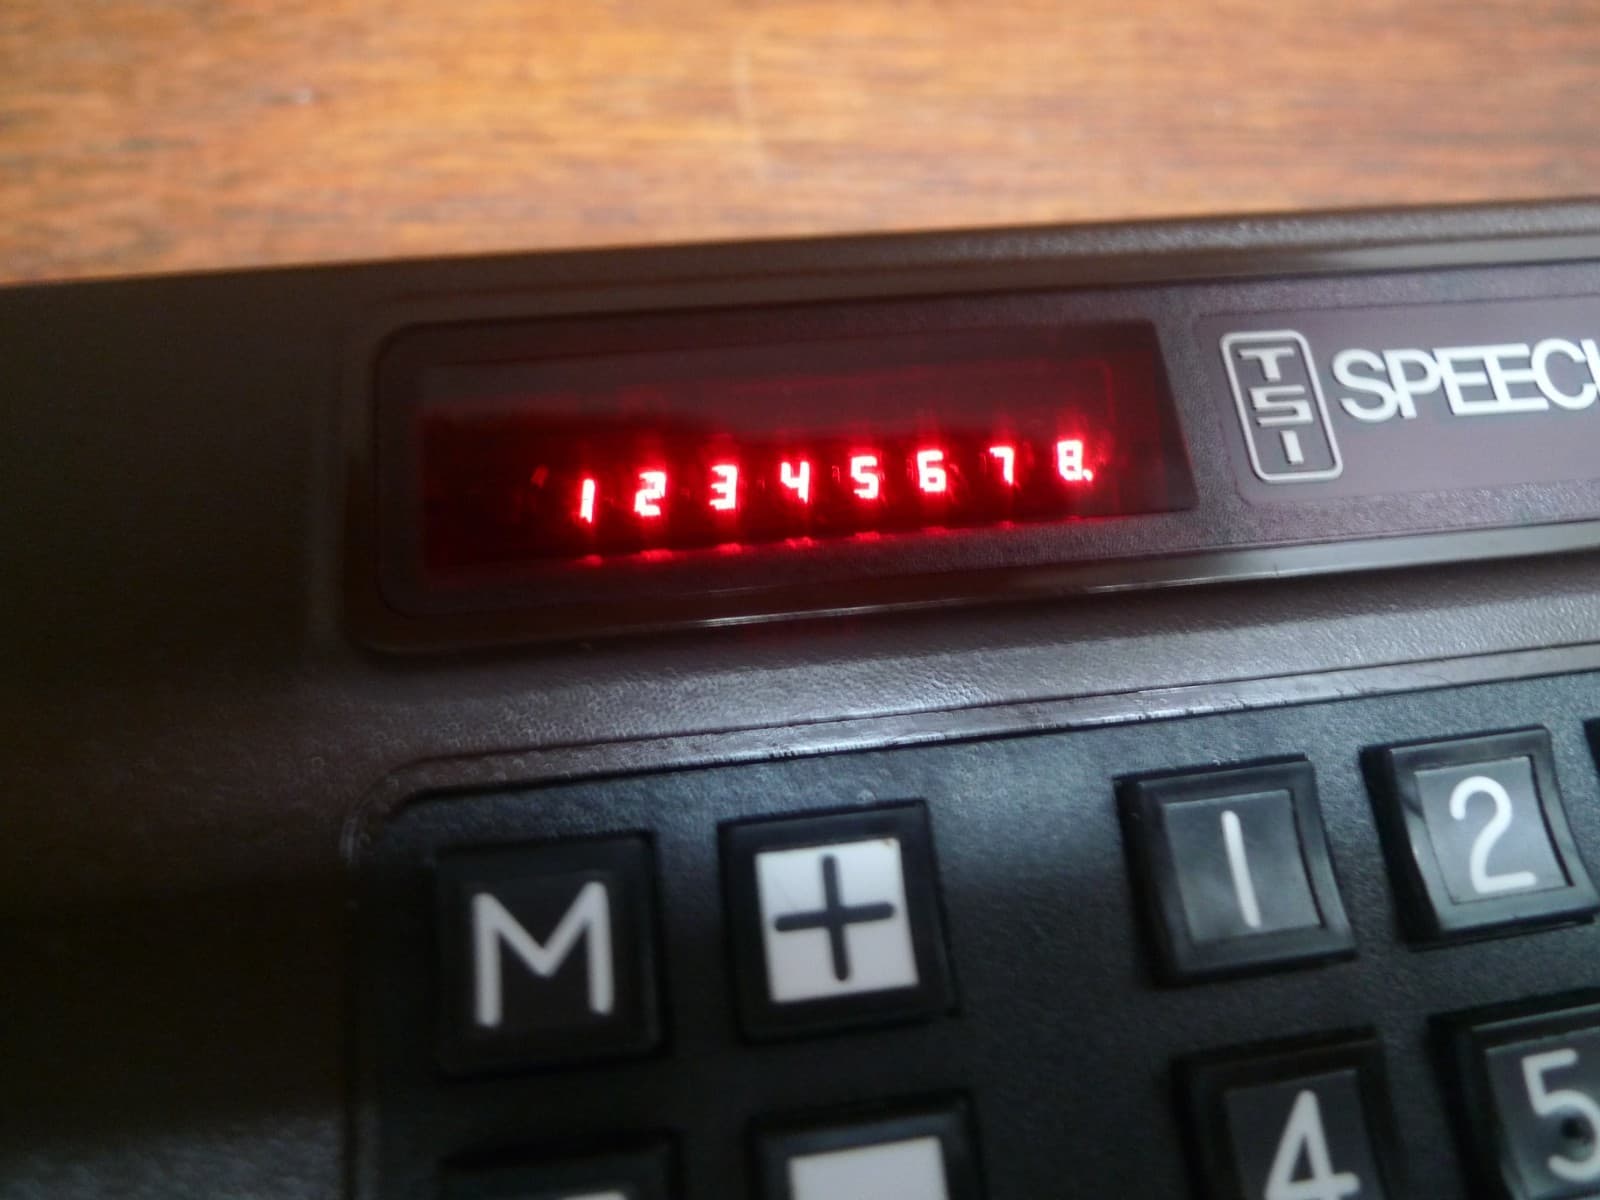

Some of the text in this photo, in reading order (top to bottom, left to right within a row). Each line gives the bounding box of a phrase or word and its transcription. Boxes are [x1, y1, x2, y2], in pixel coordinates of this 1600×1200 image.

[1220, 810, 1262, 928] 1
[1450, 776, 1538, 894] 2
[474, 880, 614, 1027] M
[1264, 1090, 1361, 1200] 4
[1522, 1048, 1600, 1182] 5
